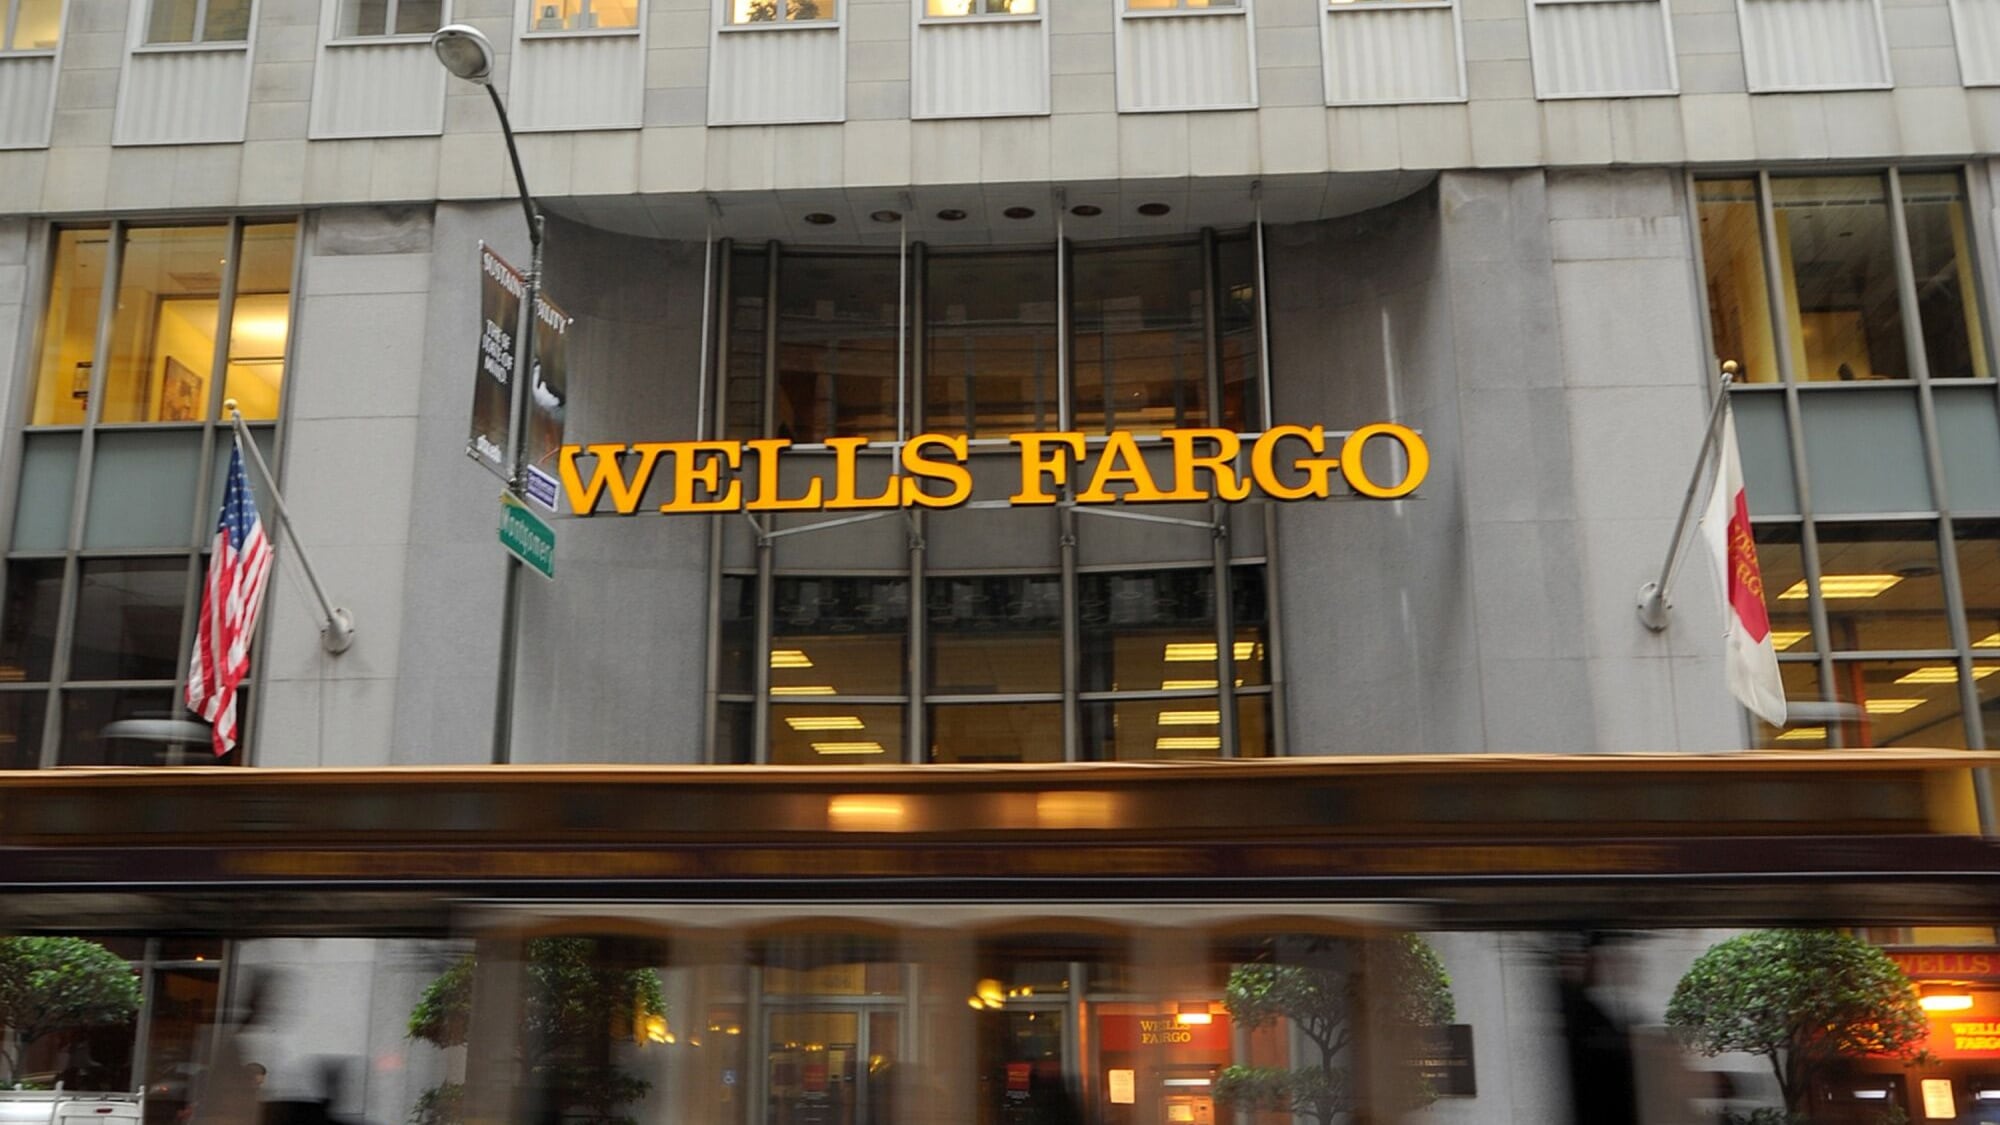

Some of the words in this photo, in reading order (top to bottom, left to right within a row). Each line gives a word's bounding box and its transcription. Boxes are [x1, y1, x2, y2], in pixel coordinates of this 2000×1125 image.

[559, 432, 973, 516] WELLS
[1009, 422, 1430, 504] FARGO
[501, 504, 554, 574] Montgomery
[1141, 1031, 1192, 1044] FARGO
